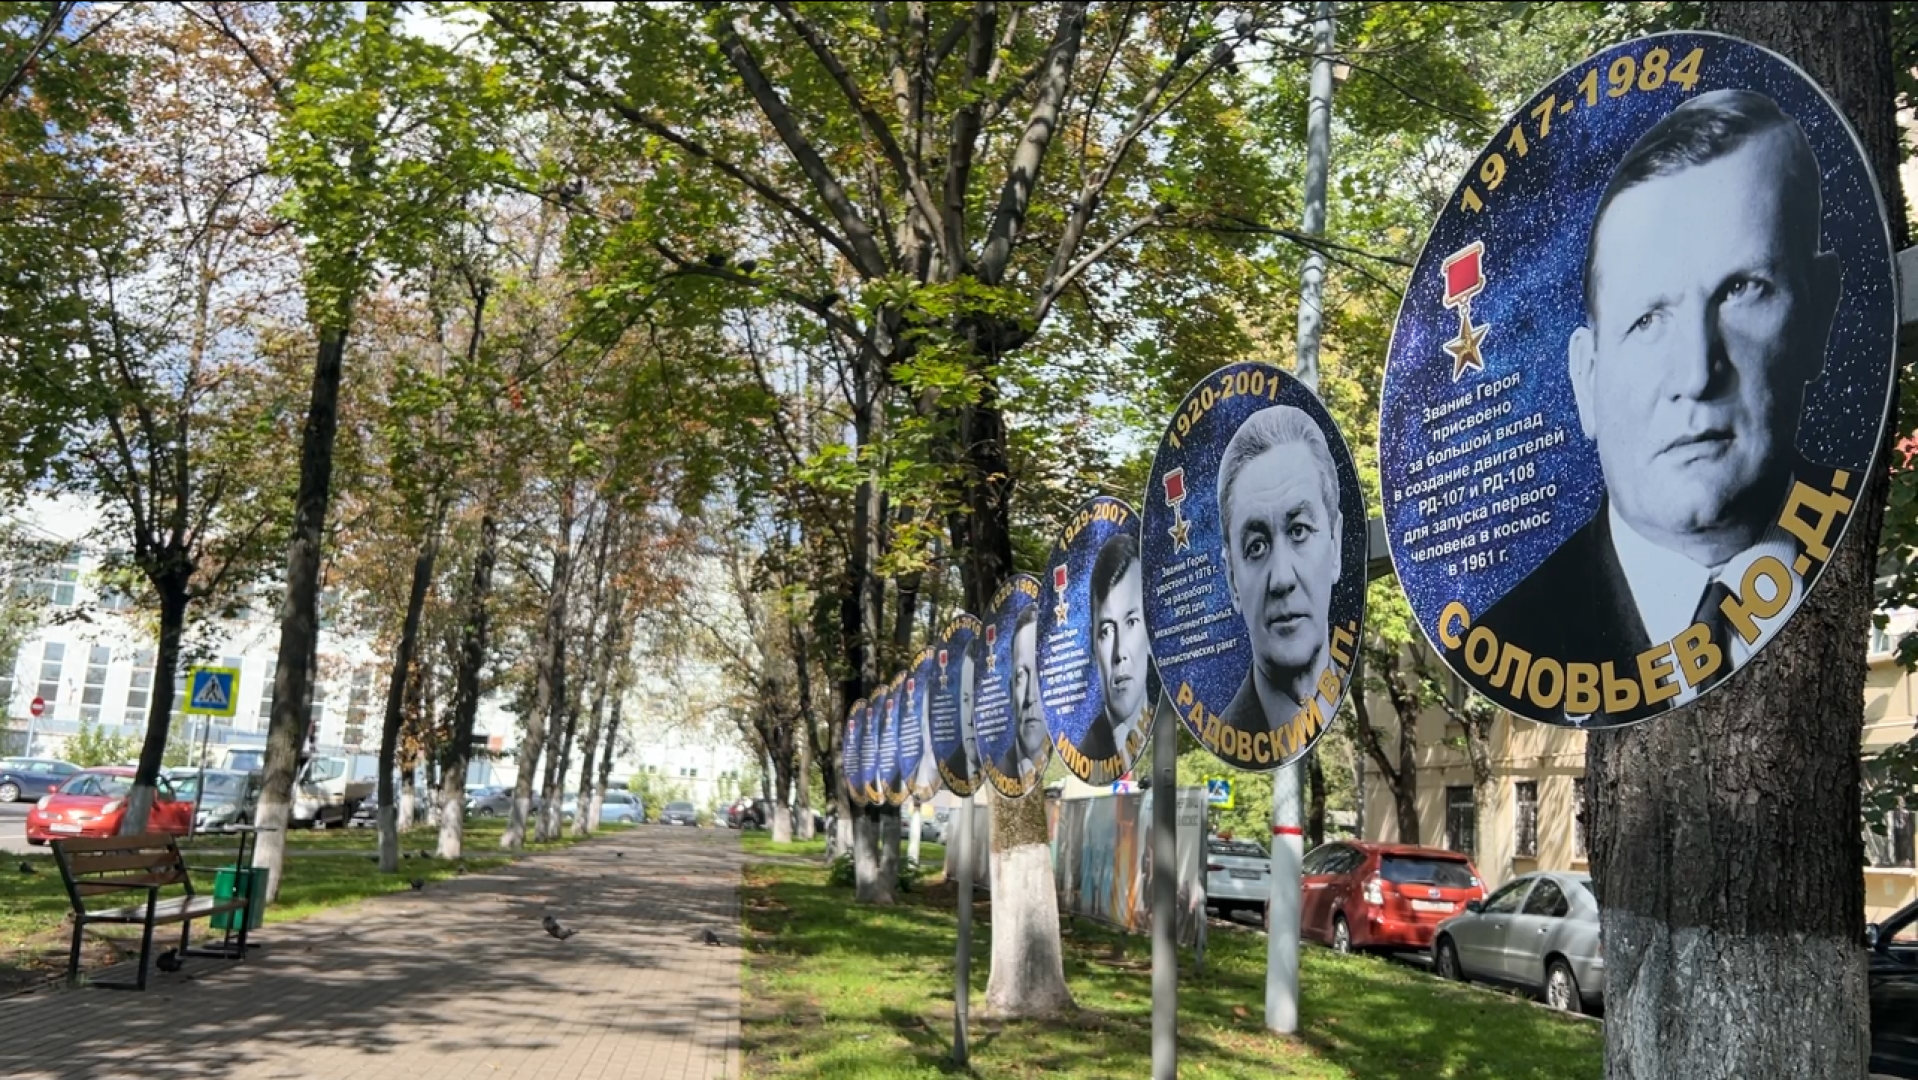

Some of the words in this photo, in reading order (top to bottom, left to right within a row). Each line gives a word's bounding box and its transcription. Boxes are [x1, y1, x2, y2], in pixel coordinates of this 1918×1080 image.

[1460, 47, 1704, 213] 1917-1984
[1169, 370, 1279, 449] 1920-2001
[1423, 392, 1473, 423] Звание
[1477, 372, 1520, 398] Героя
[1433, 402, 1511, 442] присвоено
[1394, 490, 1402, 502] в
[1405, 464, 1470, 498] создание
[1474, 426, 1565, 476] двигателей
[1409, 459, 1423, 474] за
[1427, 429, 1492, 467] большой
[1496, 412, 1543, 440] вклад
[1403, 525, 1429, 545] для
[1432, 506, 1488, 534] запуска
[1492, 484, 1557, 514] первого
[1418, 486, 1465, 516] РД-107
[1469, 485, 1478, 498] и
[1483, 462, 1535, 494] РД-108
[1059, 502, 1128, 551] 1929-2007
[1411, 535, 1475, 563] человека
[1480, 530, 1489, 543] в
[1493, 511, 1551, 538] космос
[1438, 601, 1723, 714] СОЛОВЬЕВ
[1719, 468, 1853, 646] Ю.Д.
[1448, 563, 1458, 576] в
[1463, 551, 1495, 573] 1961
[1500, 549, 1508, 563] г.
[1176, 680, 1325, 764] РАДОВСКИЙ
[1317, 620, 1356, 707] В.П.
